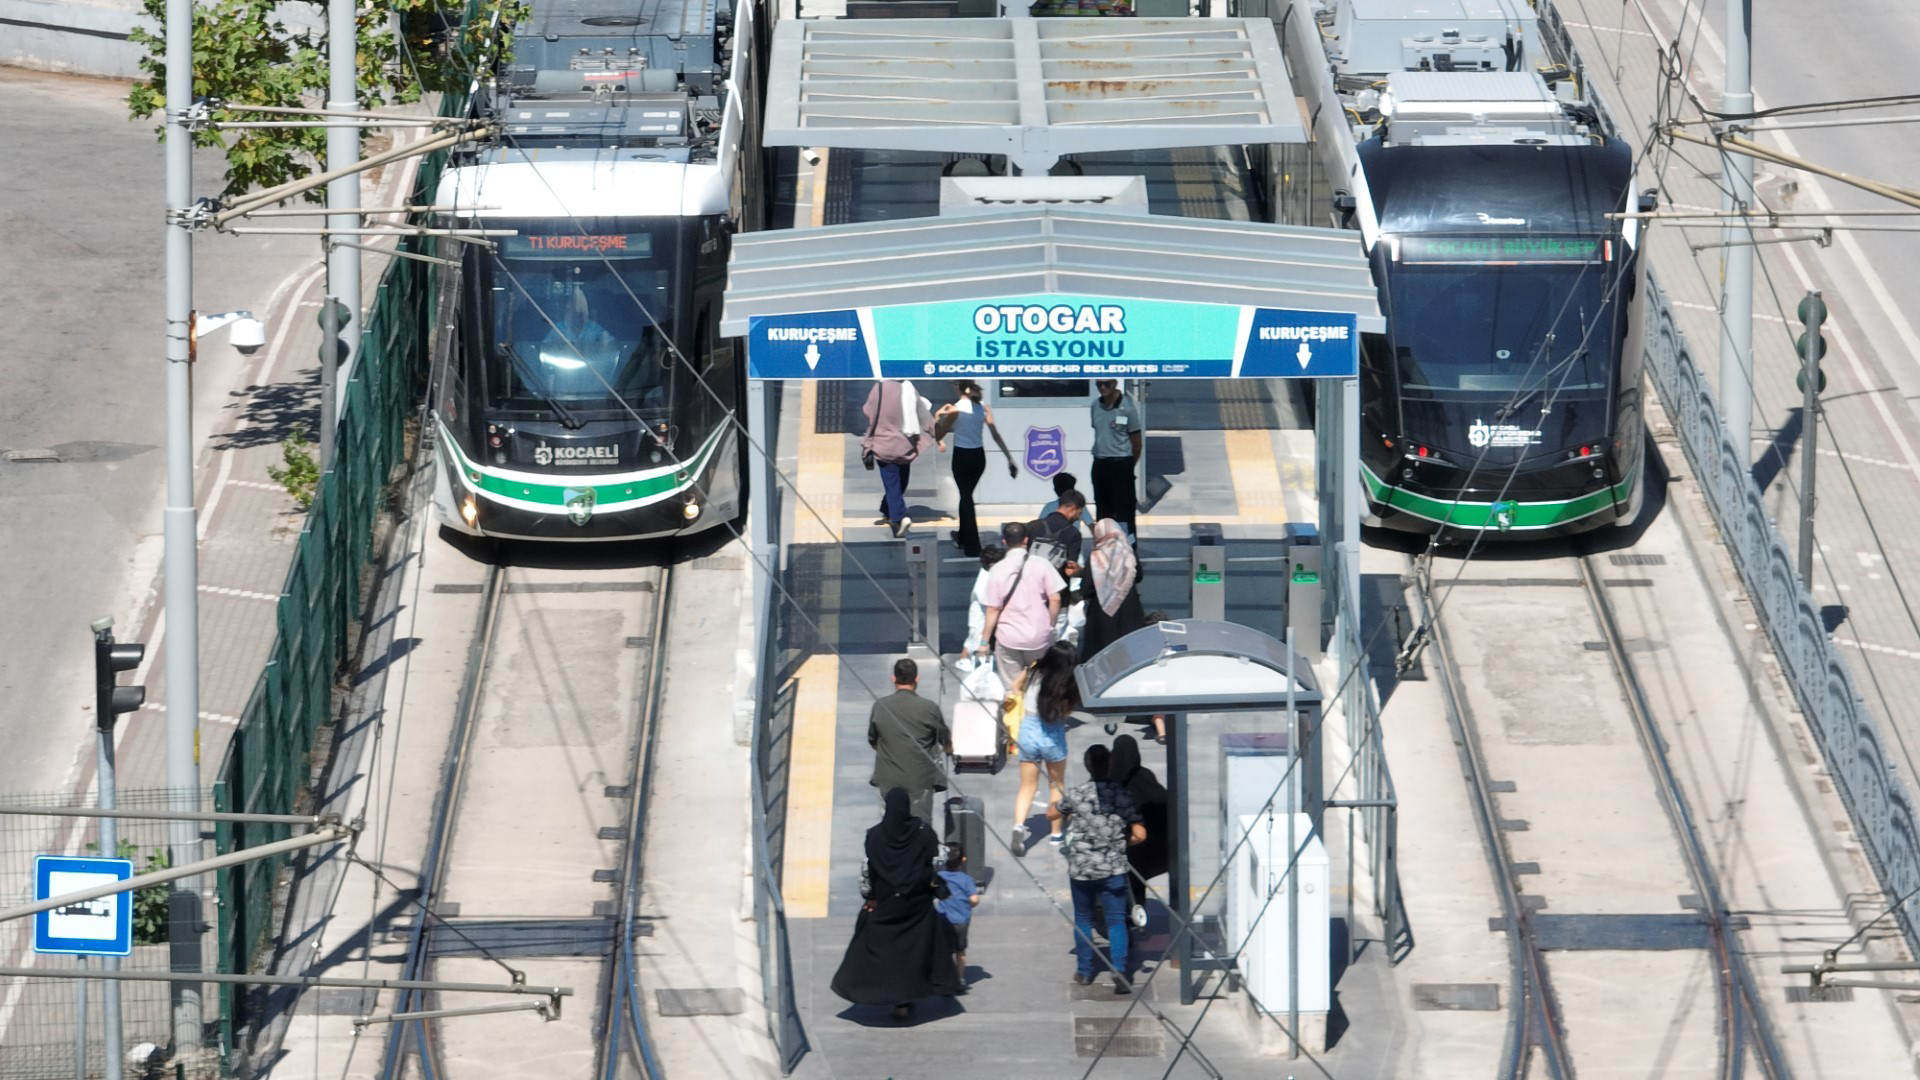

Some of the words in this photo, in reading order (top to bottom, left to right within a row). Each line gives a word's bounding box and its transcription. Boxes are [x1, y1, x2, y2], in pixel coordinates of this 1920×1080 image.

[529, 236, 544, 249] T1
[546, 236, 628, 251] KURUÇEŞME
[974, 304, 1127, 333] OTOGAR
[767, 327, 858, 344] KURUÇEŞME
[1259, 326, 1349, 342] KURUÇEŞME
[975, 336, 1125, 358] İSTASYONU
[997, 364, 1081, 375] BÜYÜKŞEHİR
[1082, 364, 1159, 374] BELEDİYESİ
[554, 444, 619, 458] KOCAELİ
